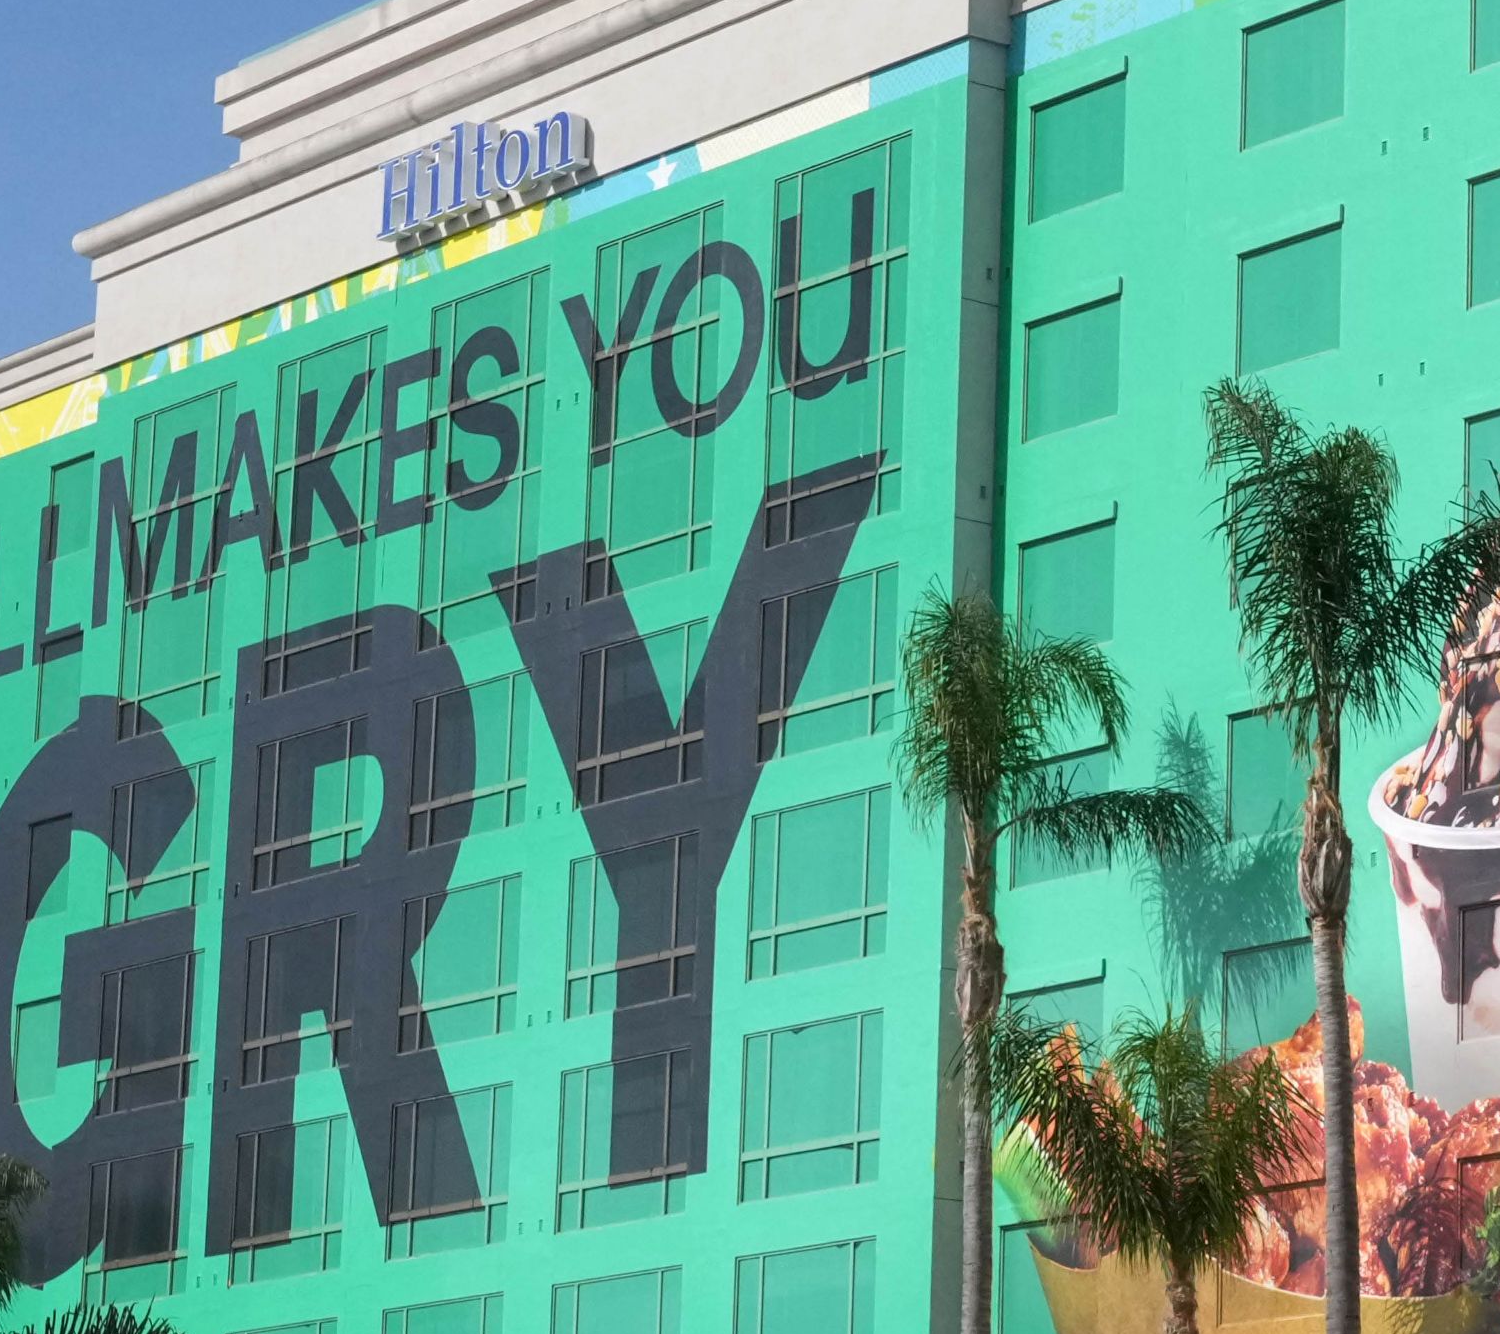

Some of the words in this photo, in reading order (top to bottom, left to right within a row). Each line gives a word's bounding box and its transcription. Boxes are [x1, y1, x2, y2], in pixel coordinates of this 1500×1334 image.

[376, 111, 574, 240] Hilton
[97, 326, 521, 629] MAKES
[560, 188, 873, 464] YOU
